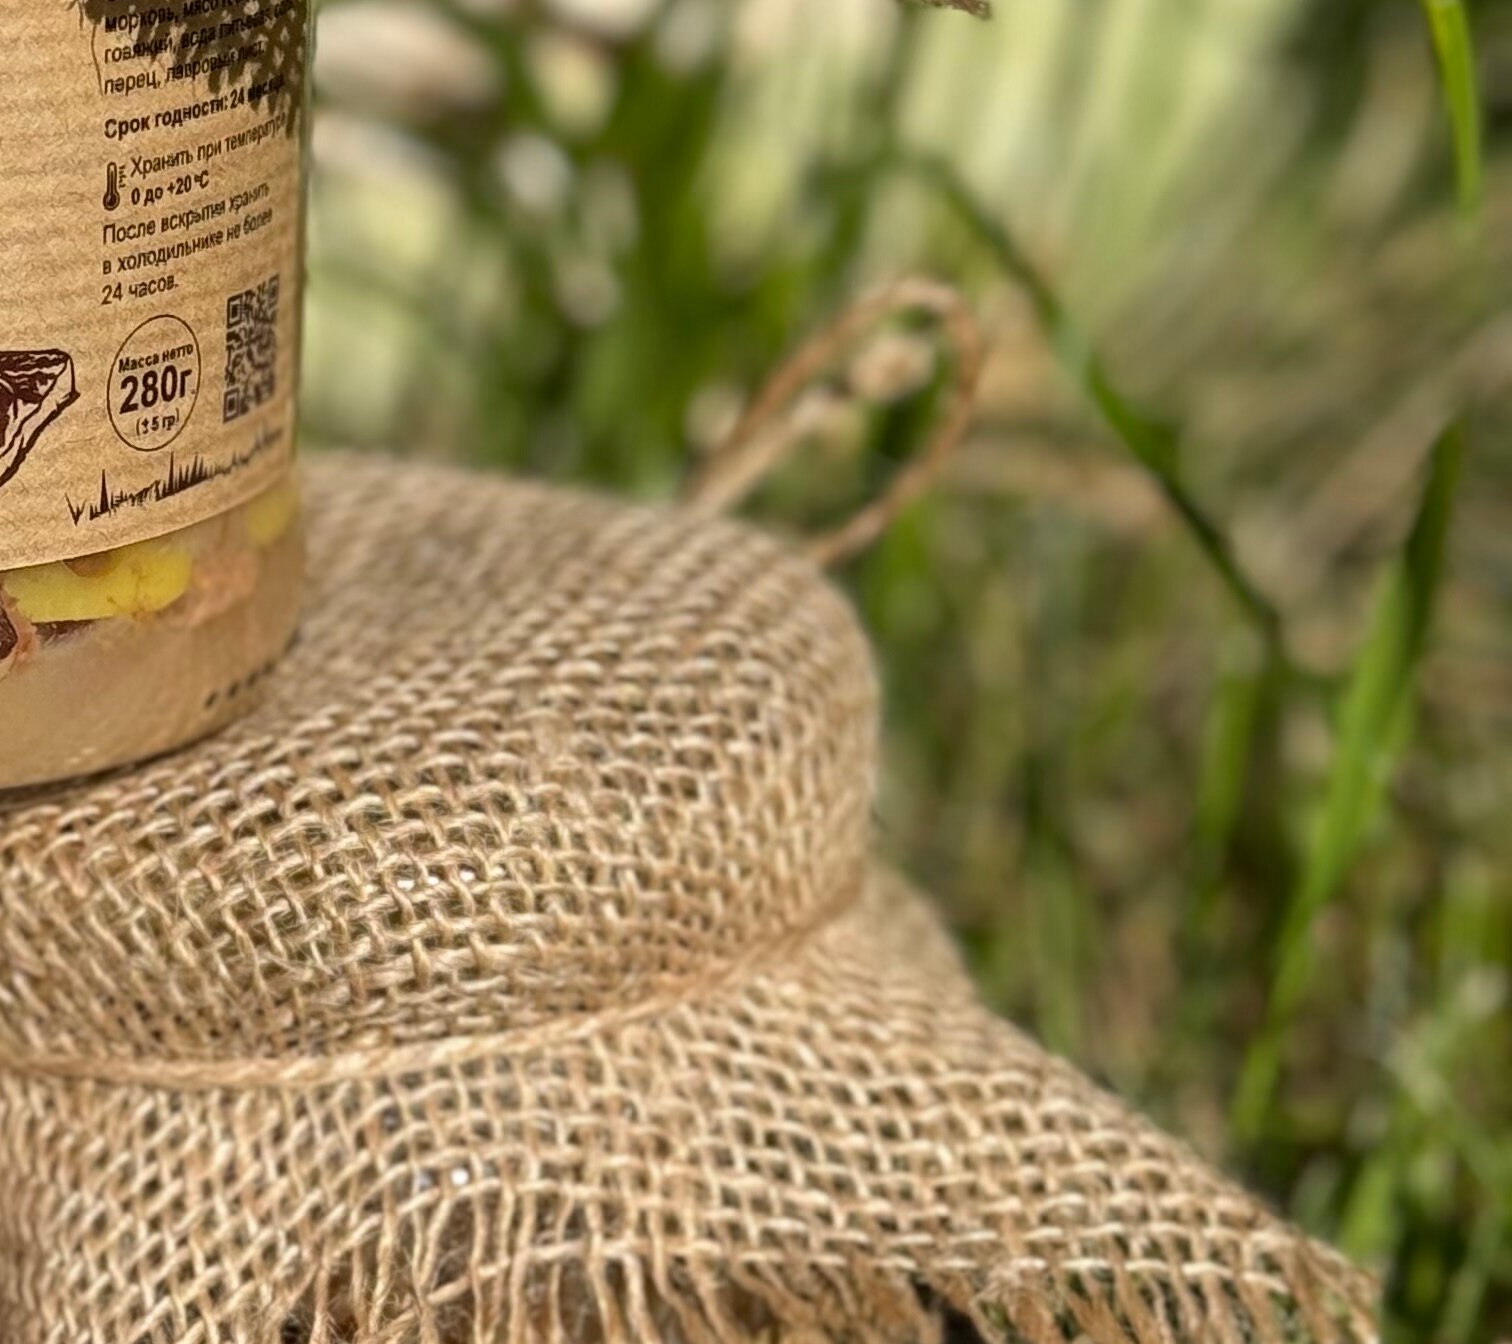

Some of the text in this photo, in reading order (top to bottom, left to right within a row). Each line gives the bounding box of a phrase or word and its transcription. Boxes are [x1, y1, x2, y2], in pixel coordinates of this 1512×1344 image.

[104, 7, 179, 34] морковь,
[104, 32, 177, 65] говяжий,
[181, 26, 216, 49] вода
[104, 70, 161, 97] перец,
[104, 115, 150, 141] Срок
[154, 94, 229, 129] годности:
[230, 85, 245, 111] 24
[130, 150, 194, 180] Хранить
[196, 140, 223, 163] при
[130, 187, 141, 206] 0
[143, 187, 164, 207] до
[166, 175, 193, 198] +20
[102, 181, 271, 246] После вскрытия хранить
[102, 206, 273, 275] в холодильнике не более
[100, 273, 180, 306] 24 часов.
[118, 342, 194, 373] Масса нетто
